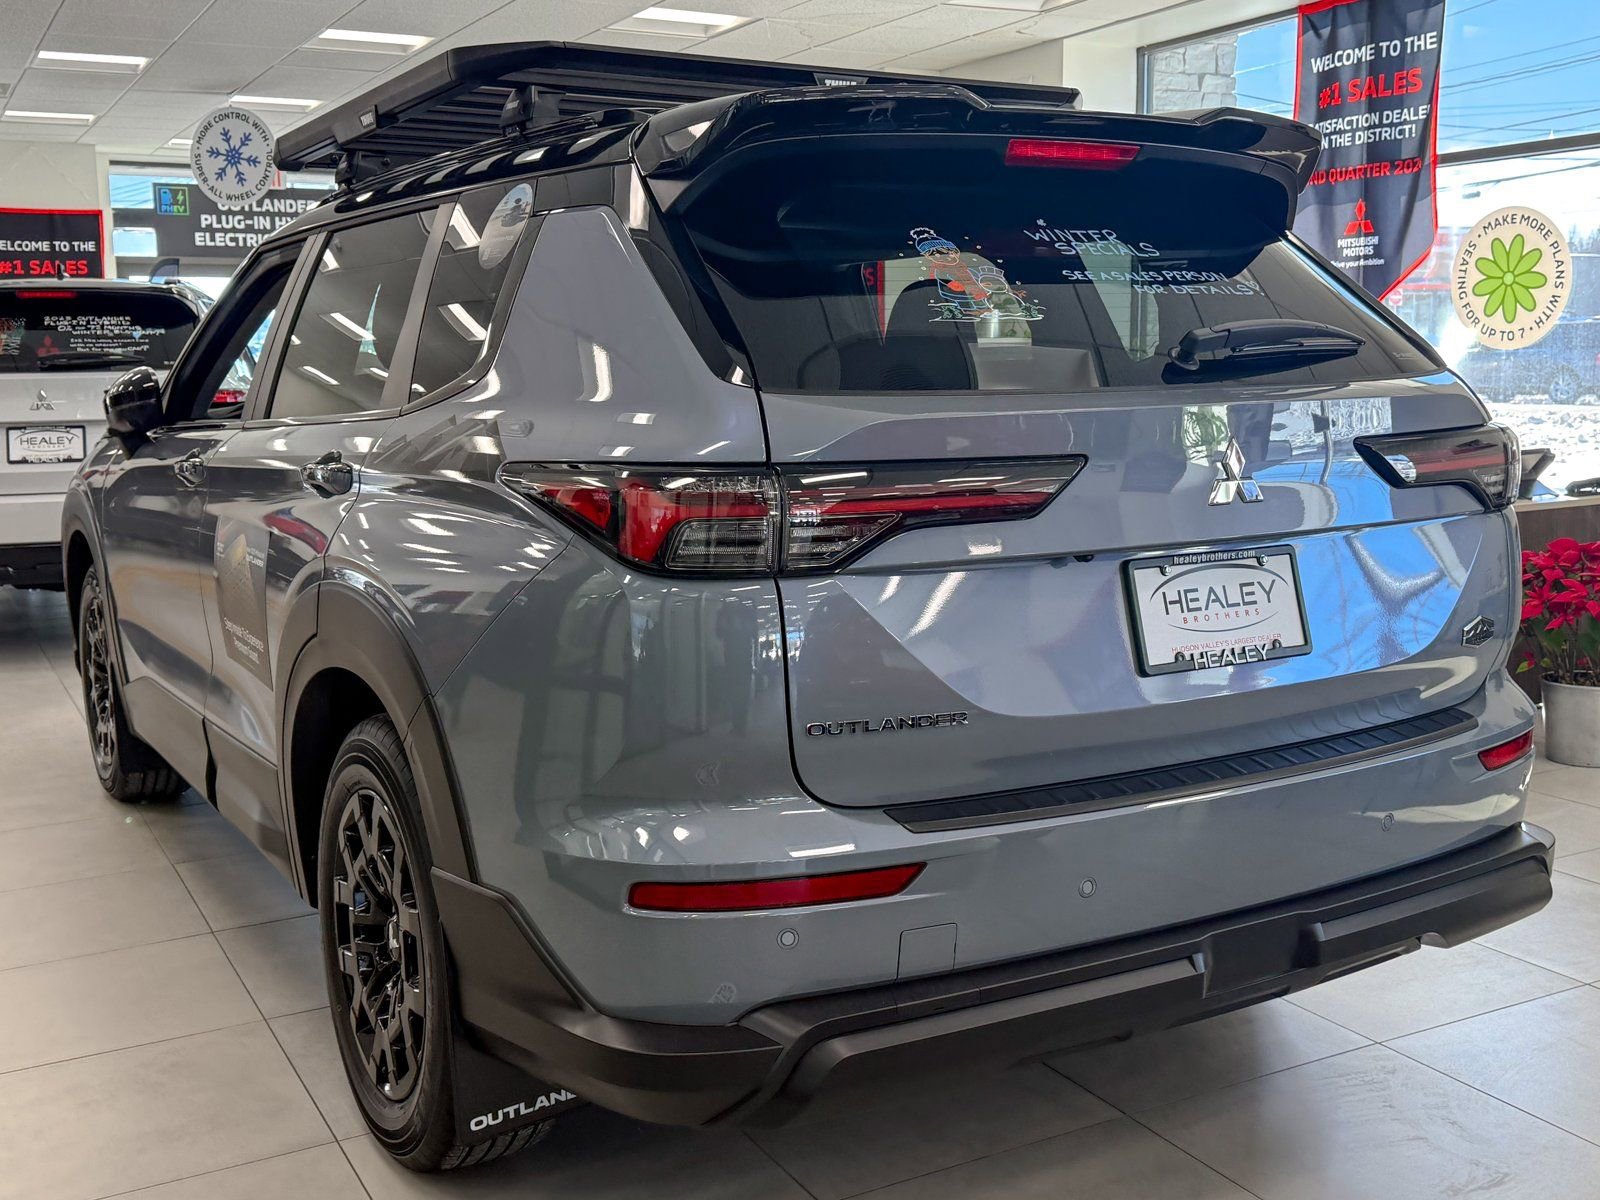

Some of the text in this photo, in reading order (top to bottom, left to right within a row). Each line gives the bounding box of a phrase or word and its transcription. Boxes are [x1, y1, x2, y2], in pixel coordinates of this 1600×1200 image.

[1310, 31, 1438, 74] WELCOME TO THE
[1318, 67, 1423, 109] #1 SALES
[1382, 104, 1431, 125] DEALE
[196, 111, 270, 145] MORE CONTROL WITH
[1330, 132, 1353, 149] THE
[1355, 123, 1416, 146] DISTRICT!
[225, 190, 256, 201] WHEEL
[255, 148, 273, 191] CONTROL
[1308, 157, 1422, 186] ND QUARTER 202
[161, 205, 184, 213] PHEV
[200, 214, 271, 230] PLUG-IN
[1023, 229, 1119, 243] WINTER
[1337, 235, 1379, 248] MITSUBISHI
[0, 240, 96, 252] ELCOME TO THE
[1054, 241, 1160, 257] SPECIALS
[1342, 246, 1374, 257] MOTORS
[0, 260, 24, 275] #1
[1062, 270, 1098, 281] SEE
[1161, 270, 1229, 282] PERSON
[1482, 213, 1566, 329] MAKE MORE PLANS WITH
[1133, 285, 1168, 295] FOR
[1457, 240, 1526, 342] SEATING FOR UP TO 7
[20, 436, 74, 446] HEALEY
[1173, 549, 1256, 565] healeybrothers.com
[1162, 579, 1276, 616] HEALEY
[1183, 608, 1260, 624] BROTHERS
[1172, 633, 1282, 654] HUDSON VALLEY'S LARGEST DEALER
[1192, 643, 1269, 670] HEALEY
[806, 711, 968, 736] OUTLANDER
